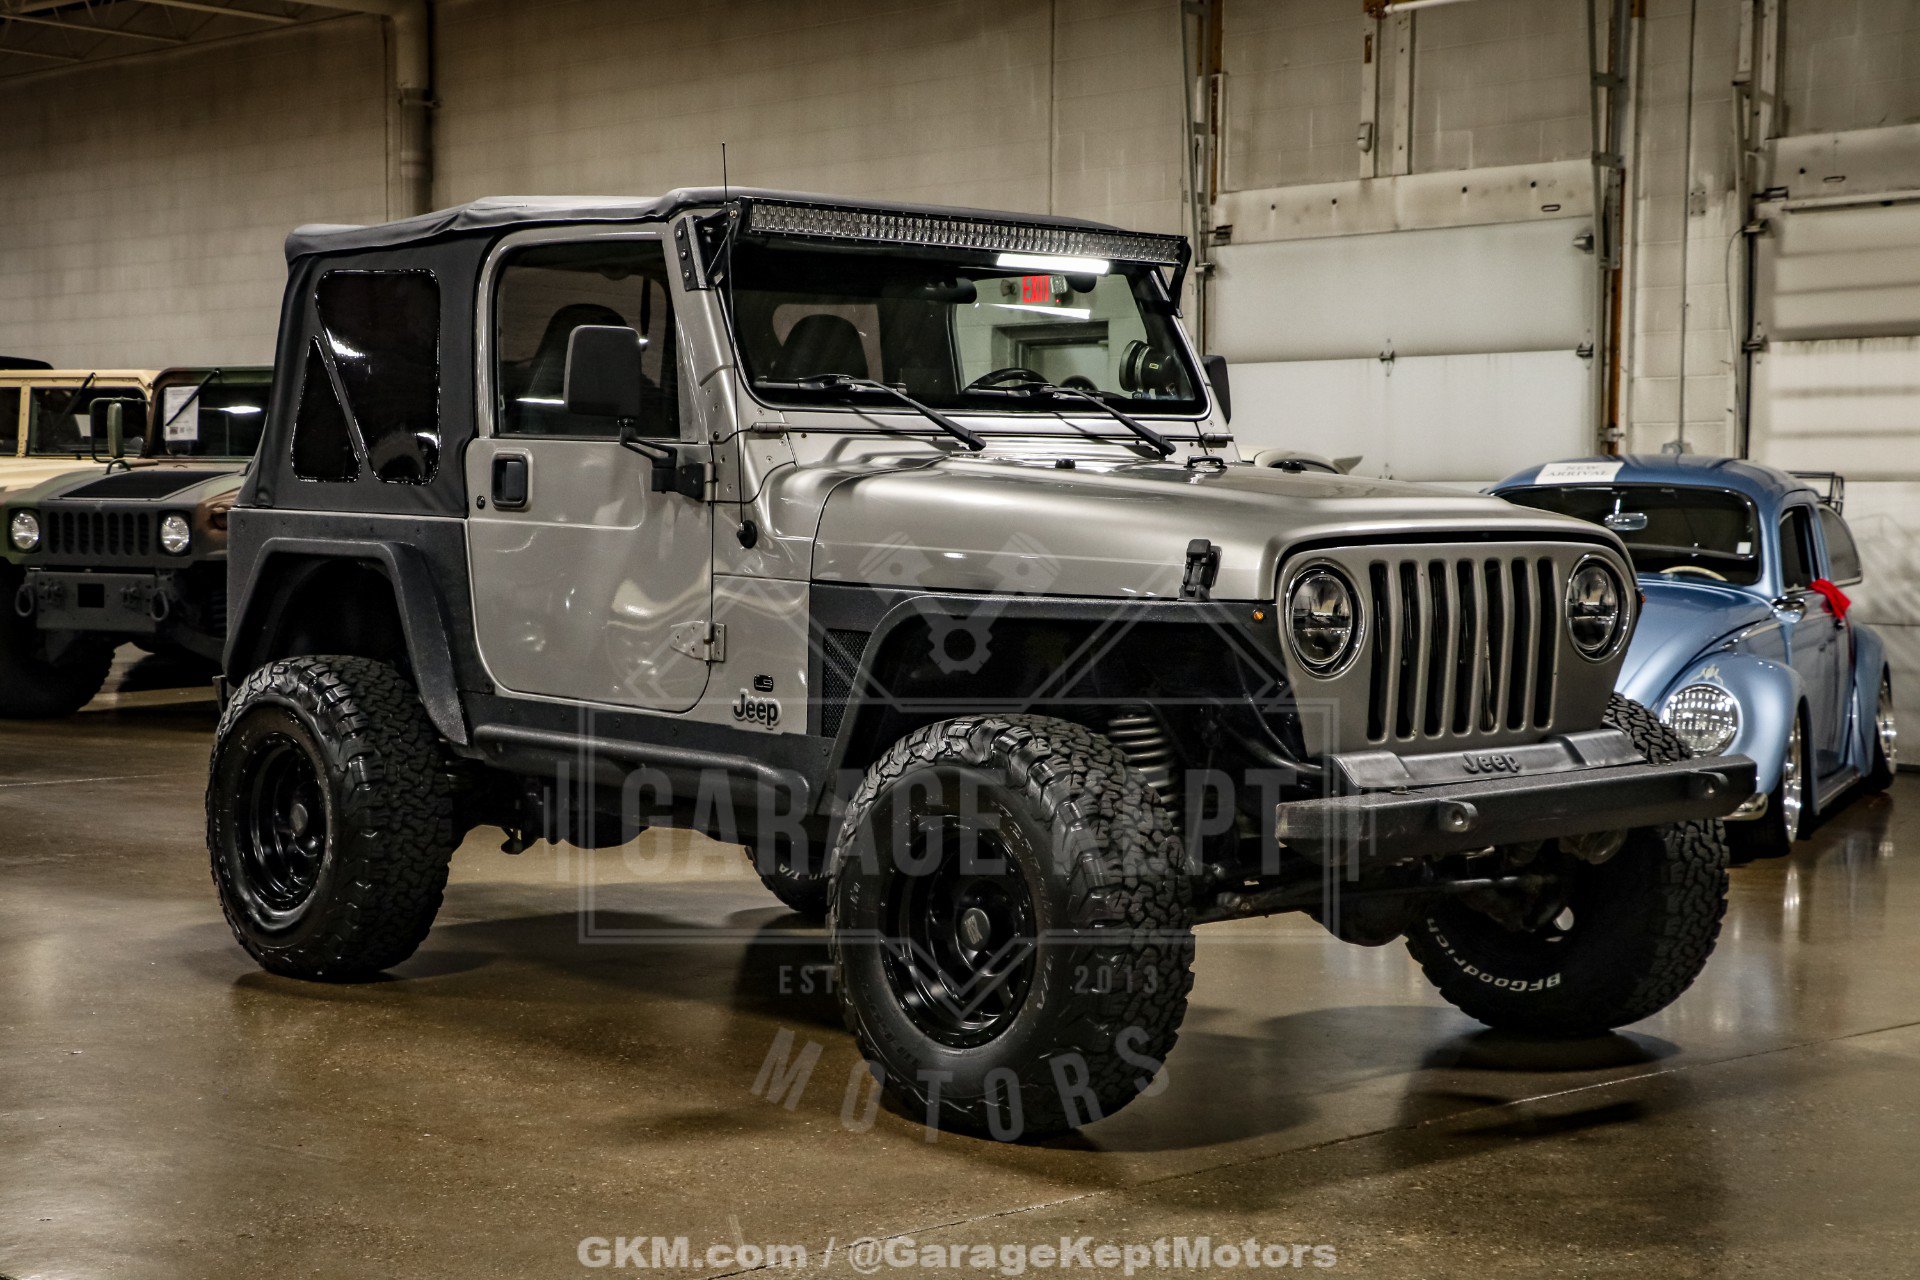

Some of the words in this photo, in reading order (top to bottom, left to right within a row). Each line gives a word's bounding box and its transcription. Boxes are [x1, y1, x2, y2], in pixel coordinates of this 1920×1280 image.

[1022, 275, 1049, 303] EXIT
[732, 688, 782, 730] Jeep
[1463, 753, 1520, 774] Jeep
[1425, 917, 1562, 993] BFGoodrich
